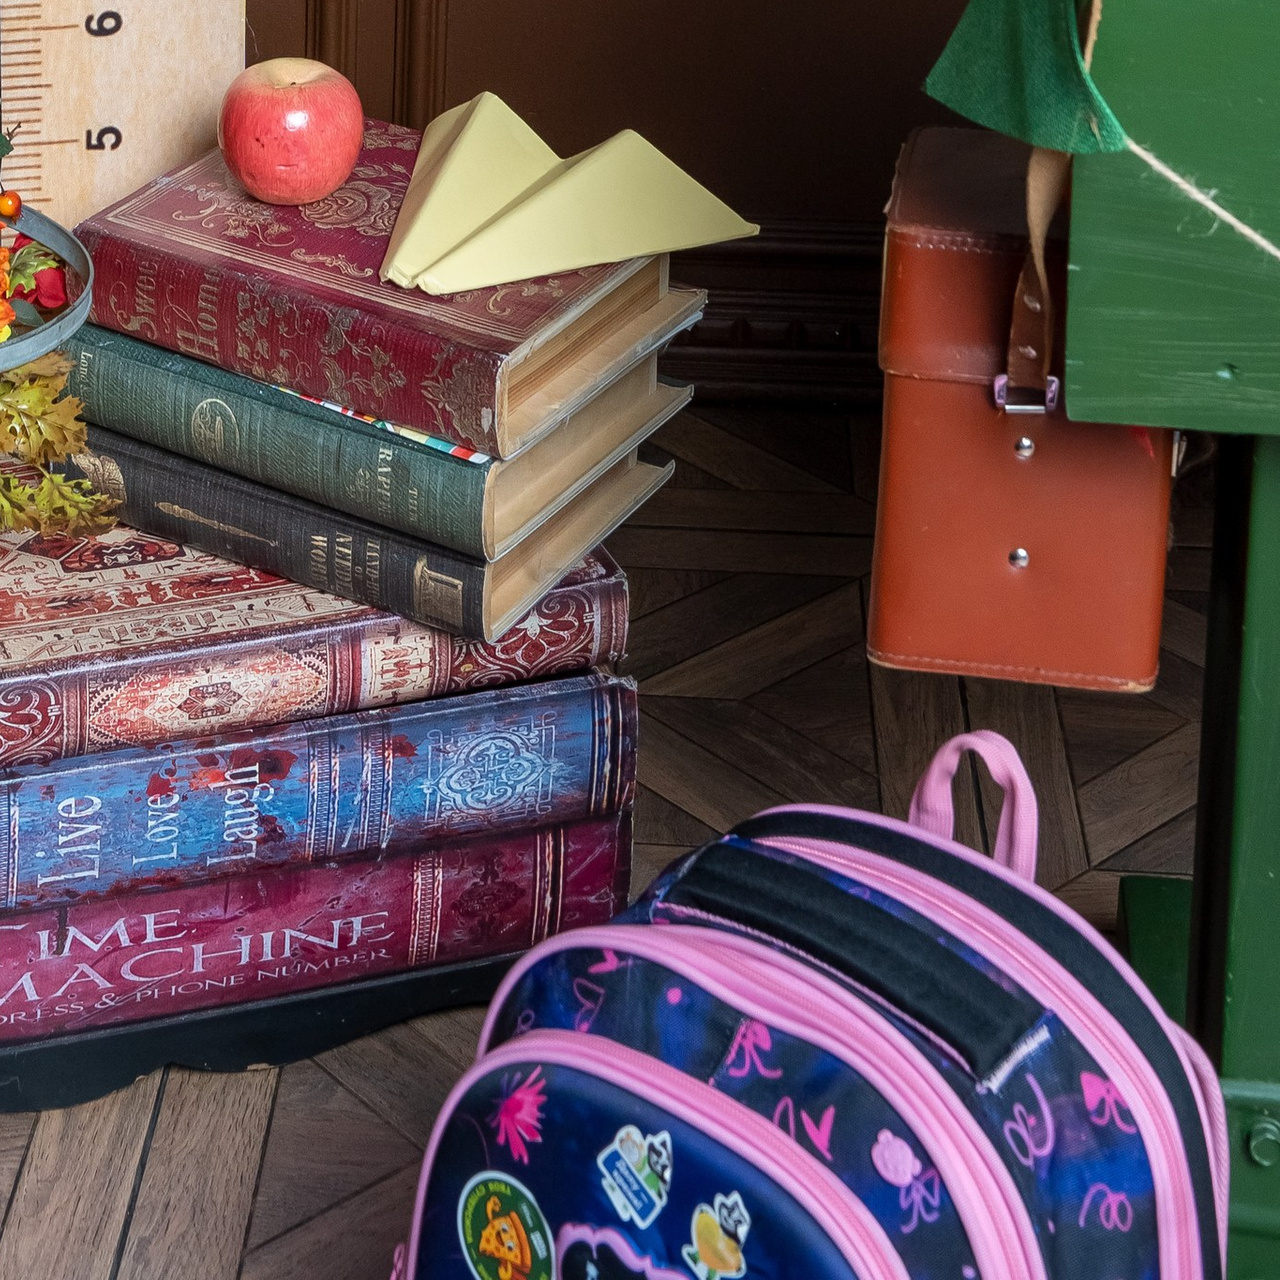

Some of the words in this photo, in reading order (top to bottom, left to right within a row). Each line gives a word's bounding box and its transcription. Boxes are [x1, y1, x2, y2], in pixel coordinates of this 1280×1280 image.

[84, 10, 123, 37] 6
[85, 126, 122, 151] 5
[37, 795, 102, 888] Live
[132, 791, 180, 866] Love
[206, 762, 275, 867] Laugh
[95, 992, 122, 1010] &
[134, 972, 246, 1003] PHONE
[257, 947, 393, 982] NUMBER
